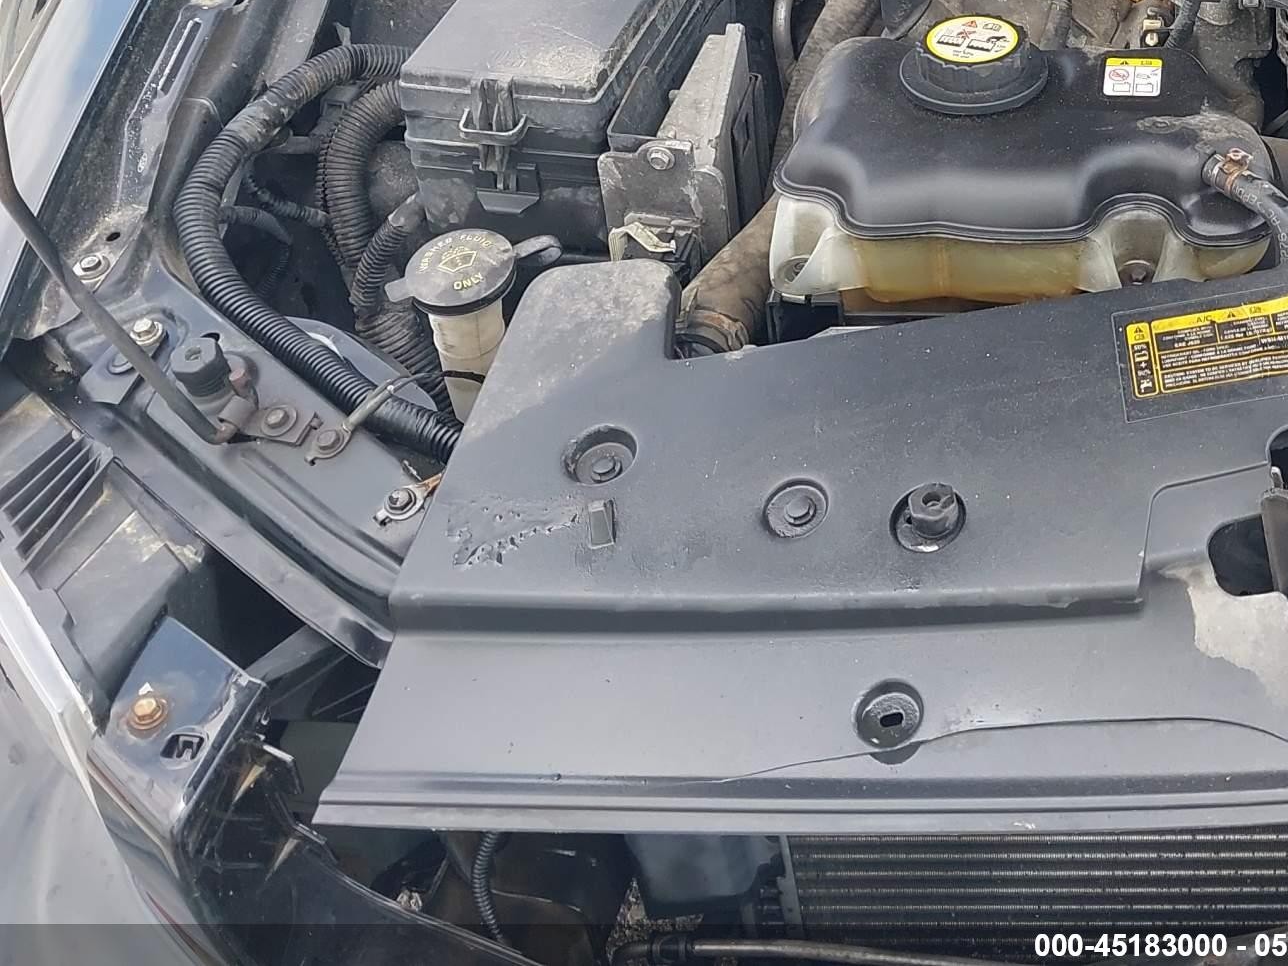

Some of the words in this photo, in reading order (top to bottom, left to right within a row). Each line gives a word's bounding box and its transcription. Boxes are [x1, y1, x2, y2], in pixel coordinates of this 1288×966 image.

[460, 234, 494, 248] FLUID
[453, 272, 484, 290] ONLY
[1196, 315, 1212, 323] A/C
